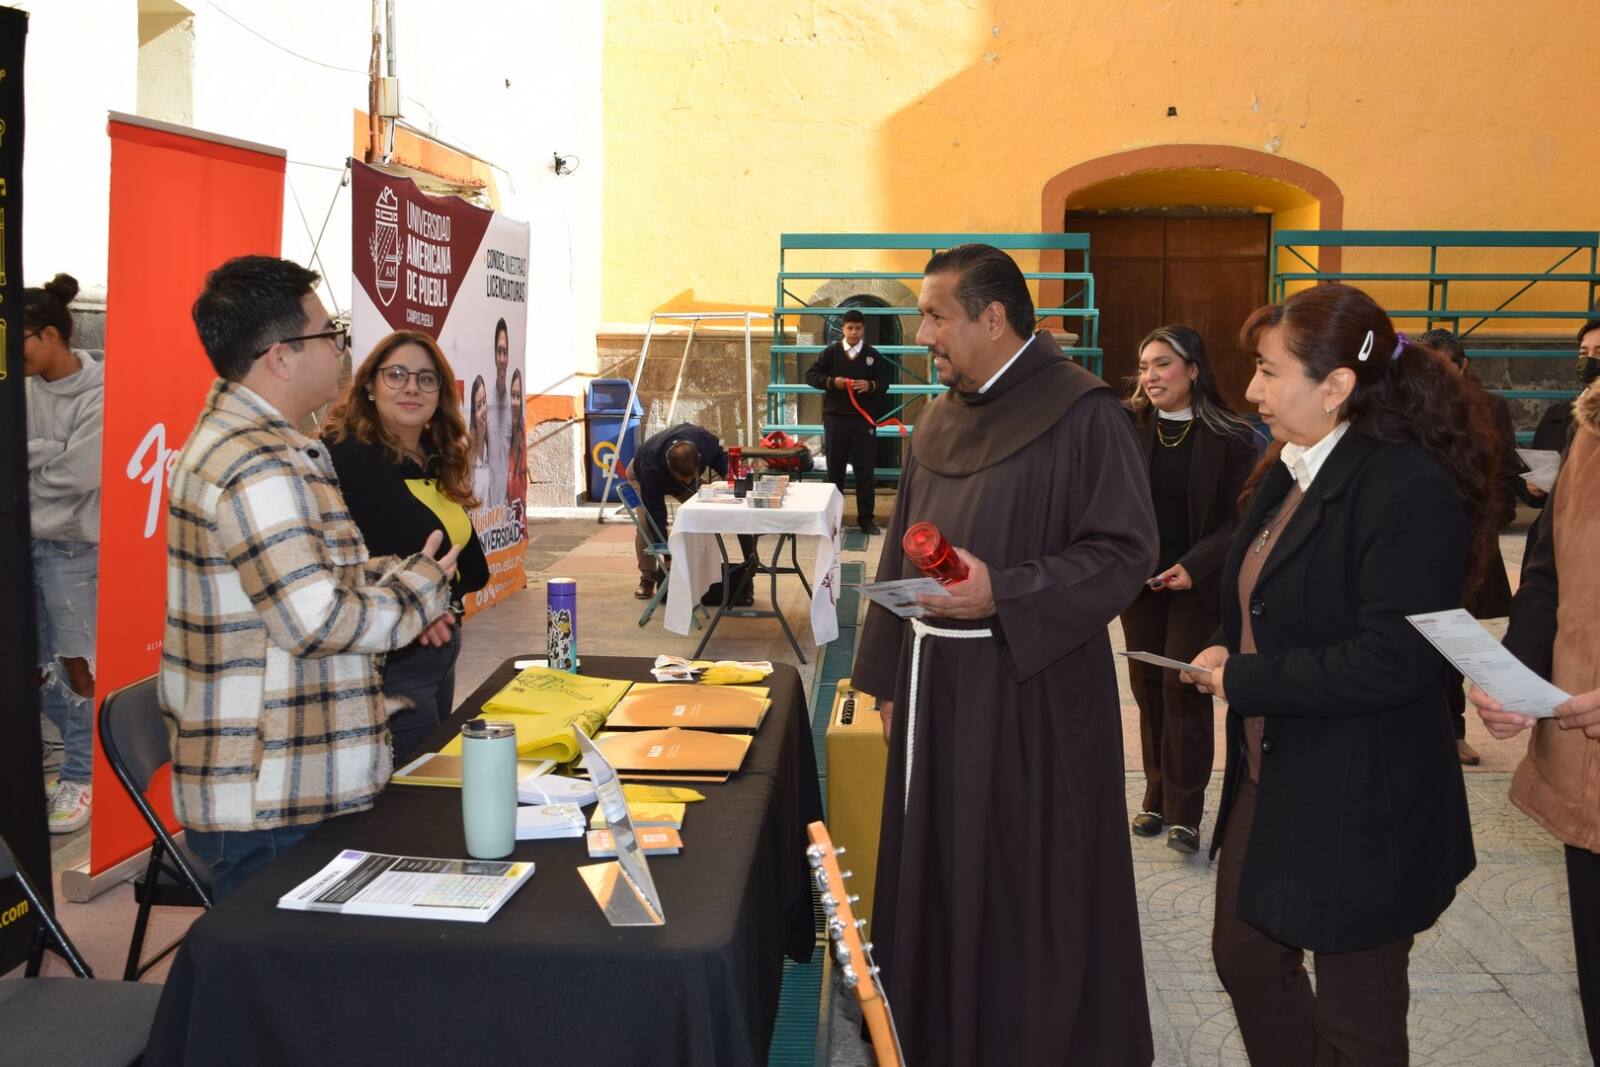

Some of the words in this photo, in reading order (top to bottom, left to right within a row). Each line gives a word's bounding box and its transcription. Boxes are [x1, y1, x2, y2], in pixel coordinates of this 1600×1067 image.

[407, 200, 451, 241] UNIVERSIDAD
[407, 234, 451, 274] AMERICANA
[487, 249, 505, 272] CONOCE
[407, 269, 418, 304] DE
[418, 274, 448, 307] PUEBLA
[487, 274, 525, 302] LICENCIATURAS
[479, 521, 521, 554] NIVERSIDAD
